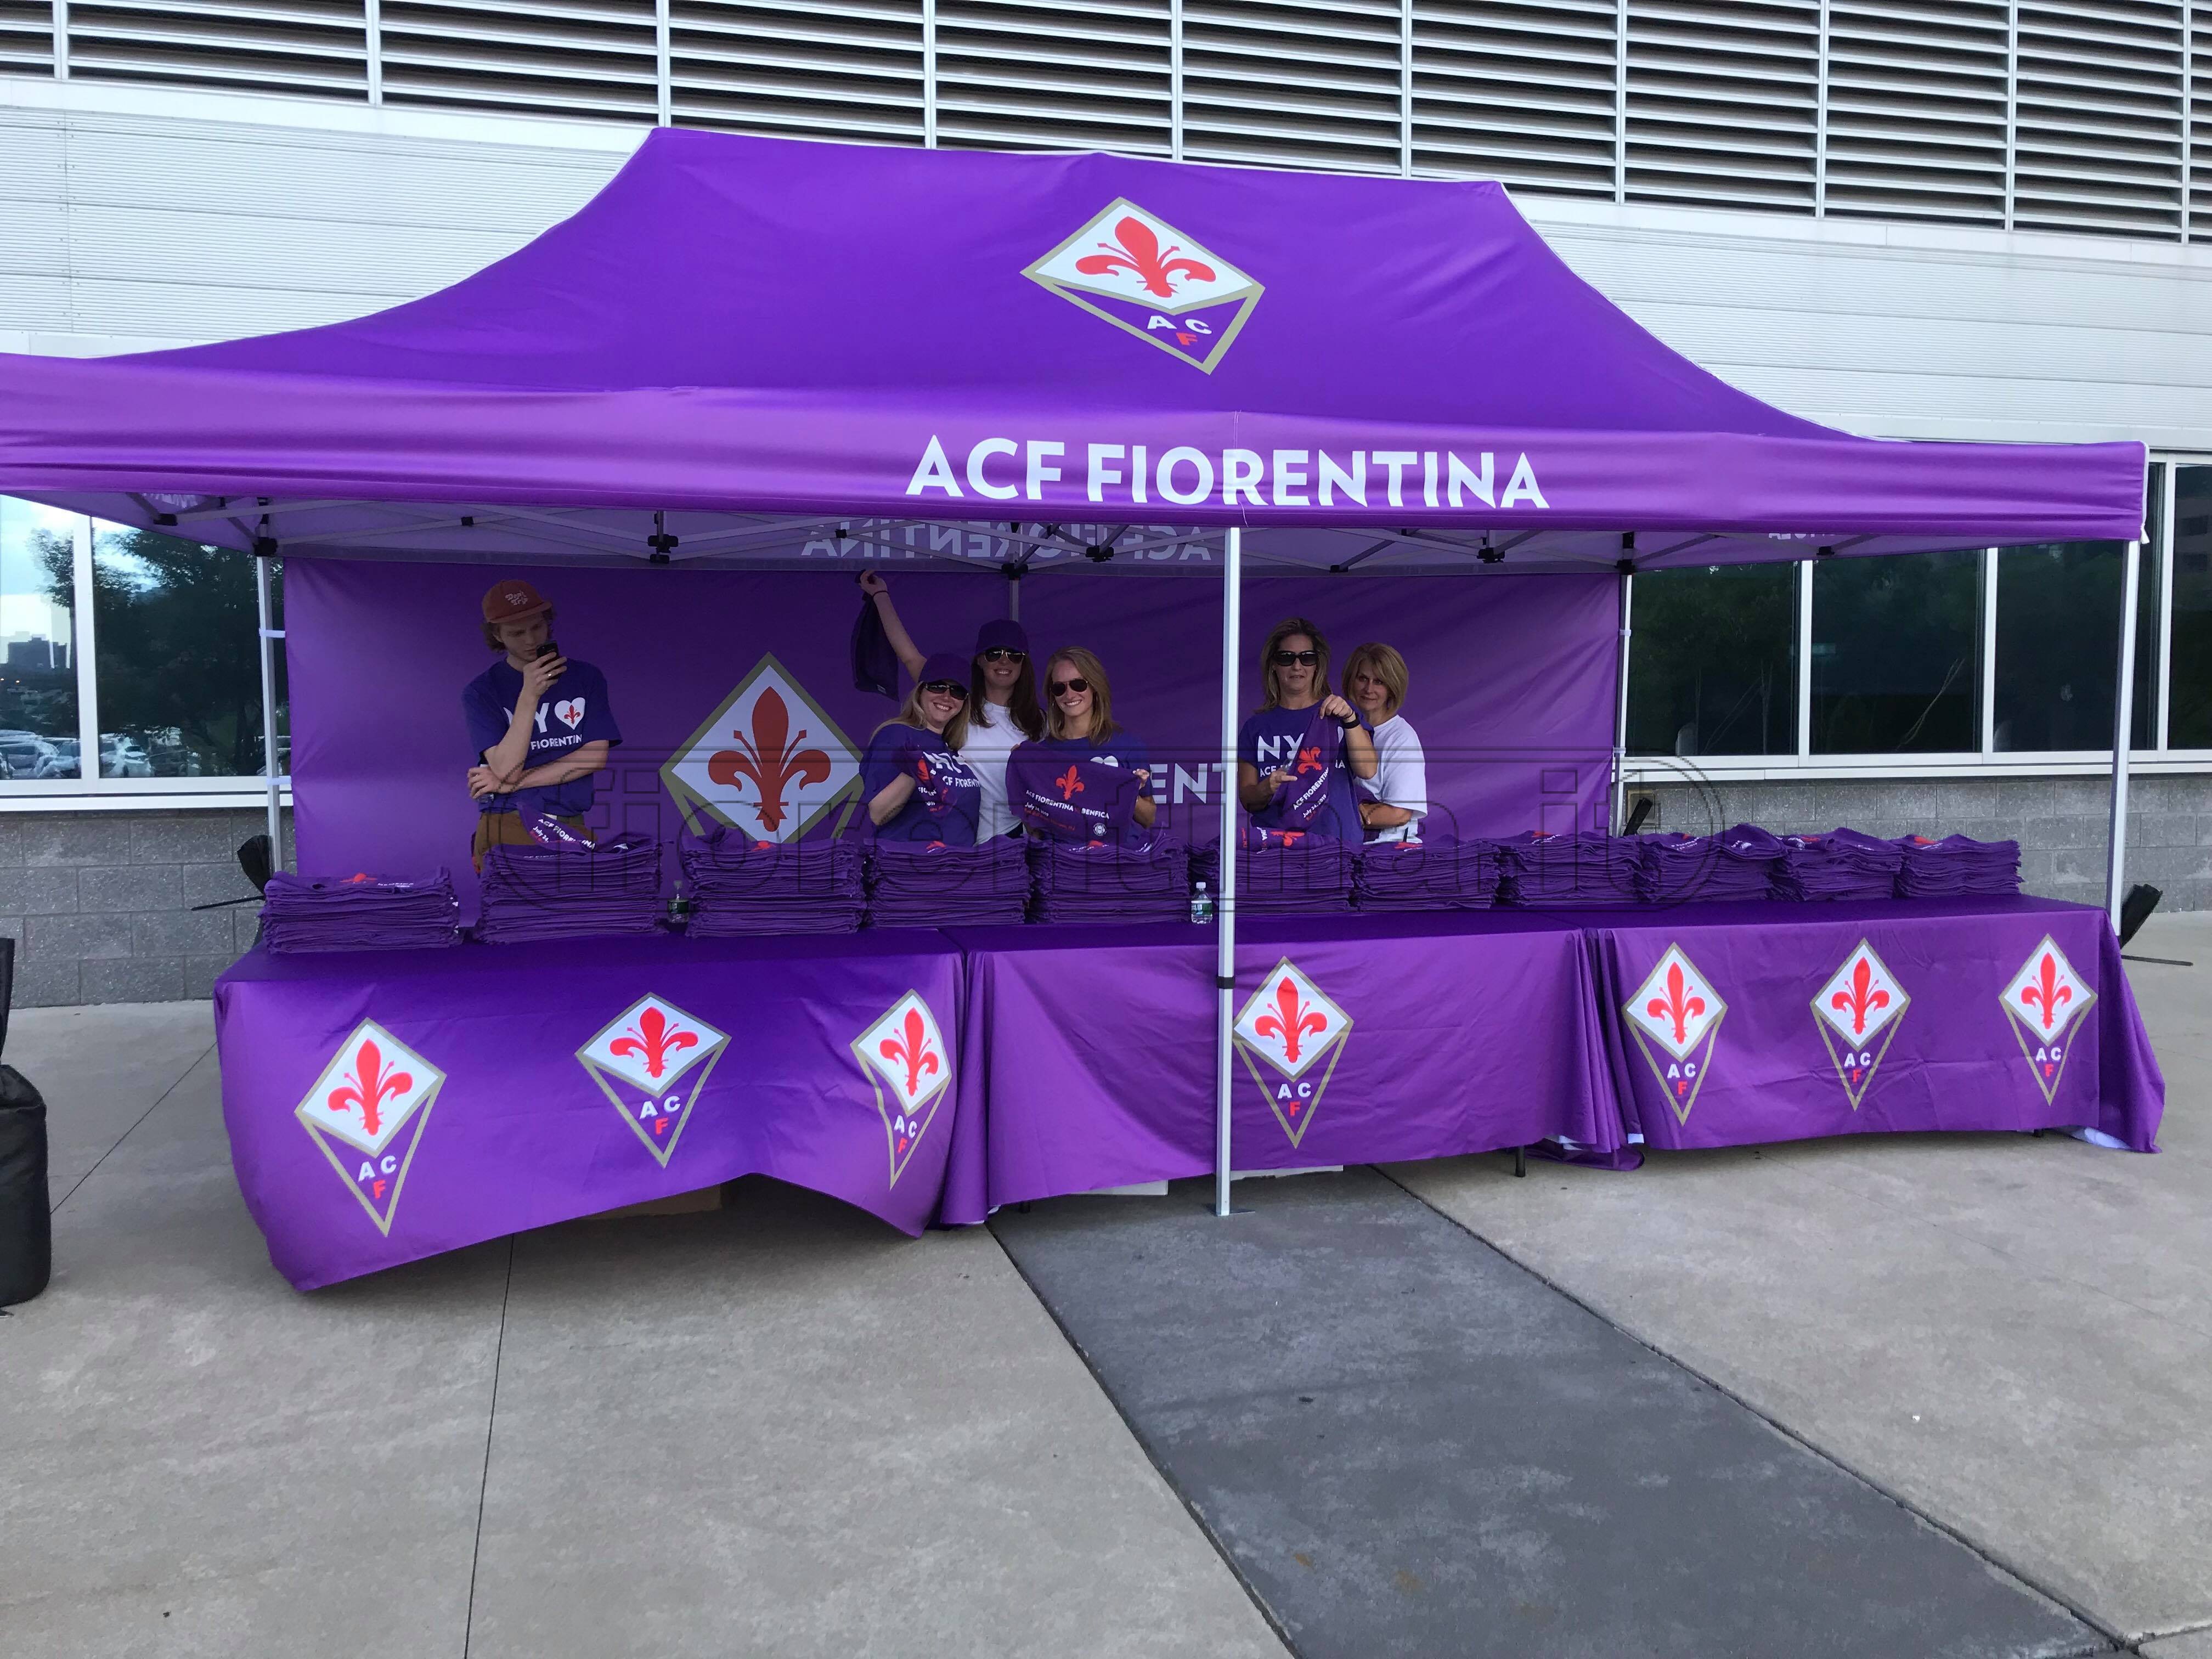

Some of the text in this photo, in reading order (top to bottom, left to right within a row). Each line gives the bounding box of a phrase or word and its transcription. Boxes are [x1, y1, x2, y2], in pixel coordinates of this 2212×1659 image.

[1176, 332, 1198, 346] F
[905, 435, 1550, 509] ACF FIORENTINA
[531, 734, 583, 751] FIORENTIN
[1035, 794, 1074, 812] FIORENTINA
[1081, 808, 1109, 819] BENFICA
[1293, 797, 1305, 810] ACF
[1302, 809, 1312, 818] July
[1852, 1069, 1861, 1083] F
[2045, 1064, 2053, 1077] F
[1678, 1081, 1687, 1096] F
[1289, 1101, 1300, 1116] F
[655, 1118, 668, 1135] F
[898, 1137, 907, 1153] F
[373, 1180, 386, 1199] F
